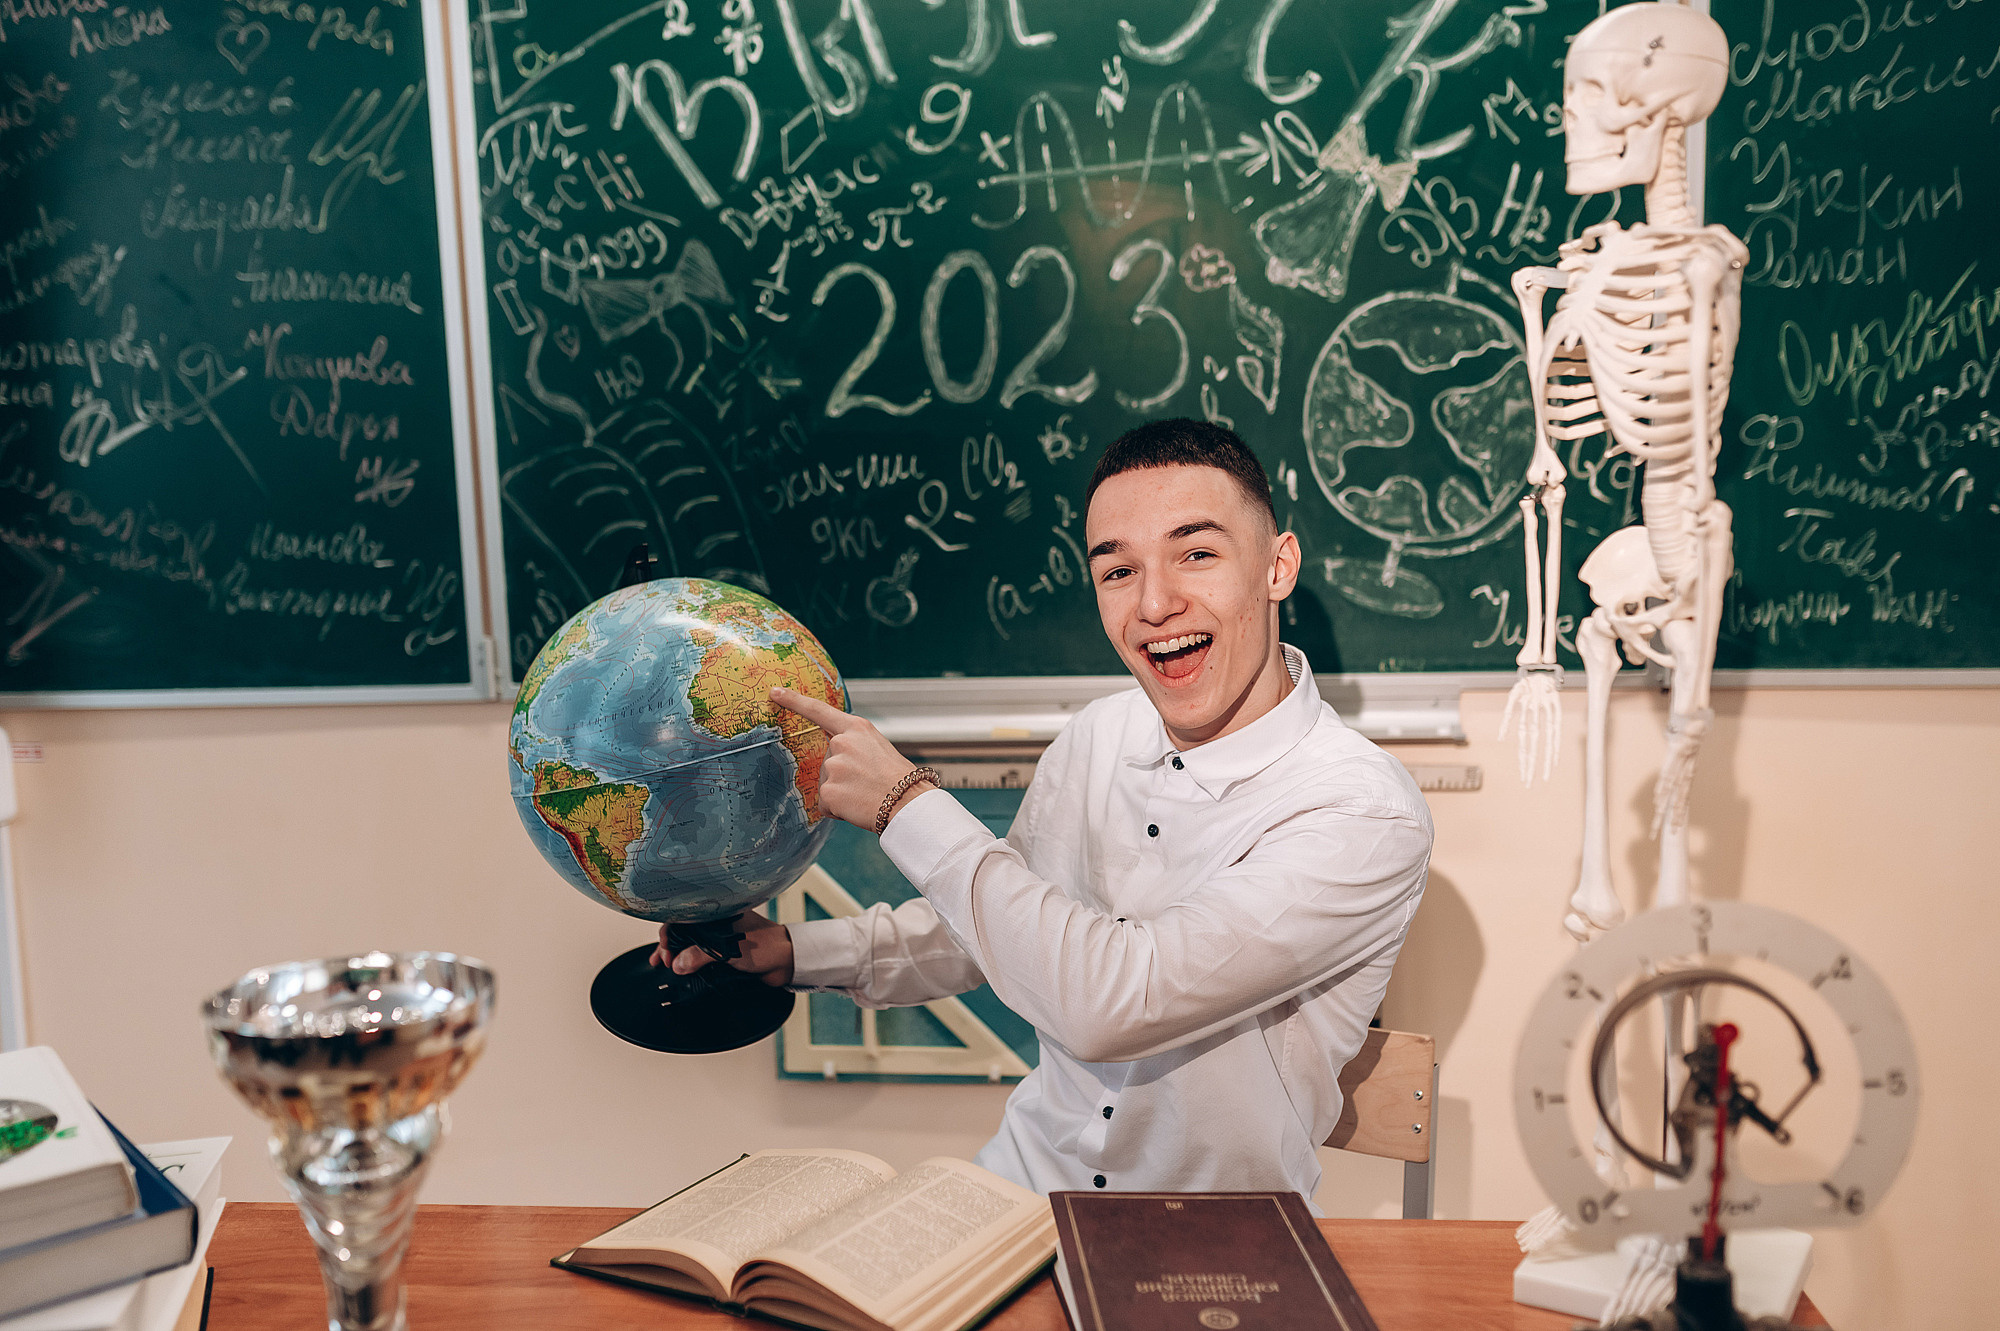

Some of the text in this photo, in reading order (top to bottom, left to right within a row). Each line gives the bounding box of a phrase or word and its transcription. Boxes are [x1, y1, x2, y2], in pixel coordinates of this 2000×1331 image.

[811, 237, 1190, 418] 2023
[1161, 1273, 1248, 1284] СЛОВАРЬ
[1161, 1292, 1262, 1303] БОЛЬШОЙ
